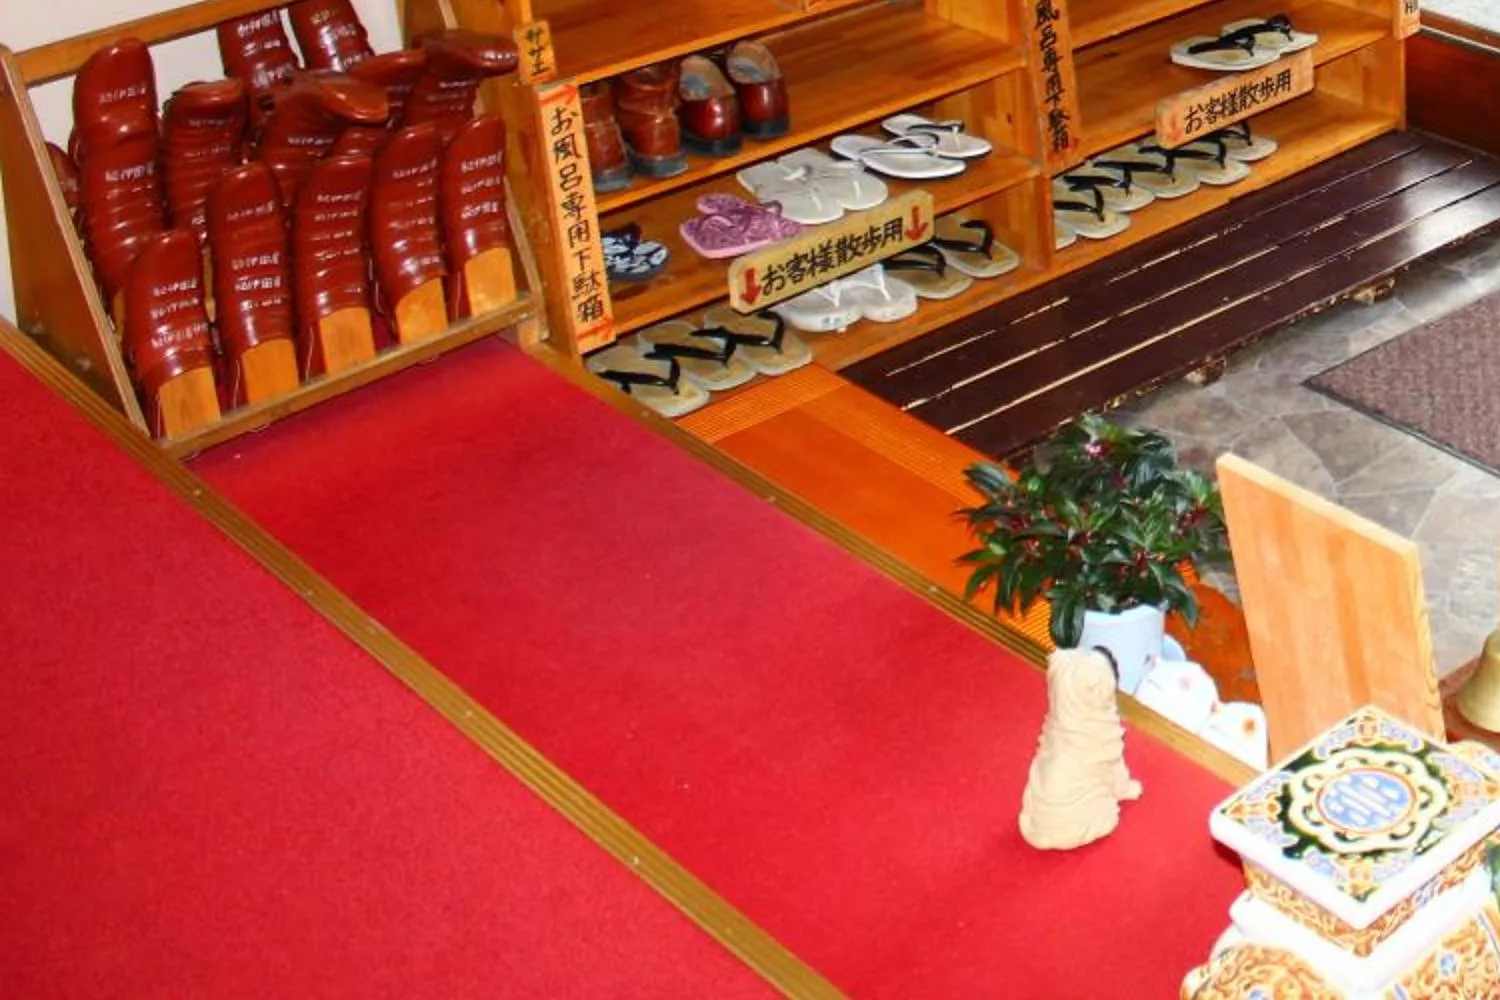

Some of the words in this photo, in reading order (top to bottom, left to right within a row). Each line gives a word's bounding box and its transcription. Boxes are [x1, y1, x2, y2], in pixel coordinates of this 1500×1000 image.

[761, 216, 904, 296] お客様散歩用
